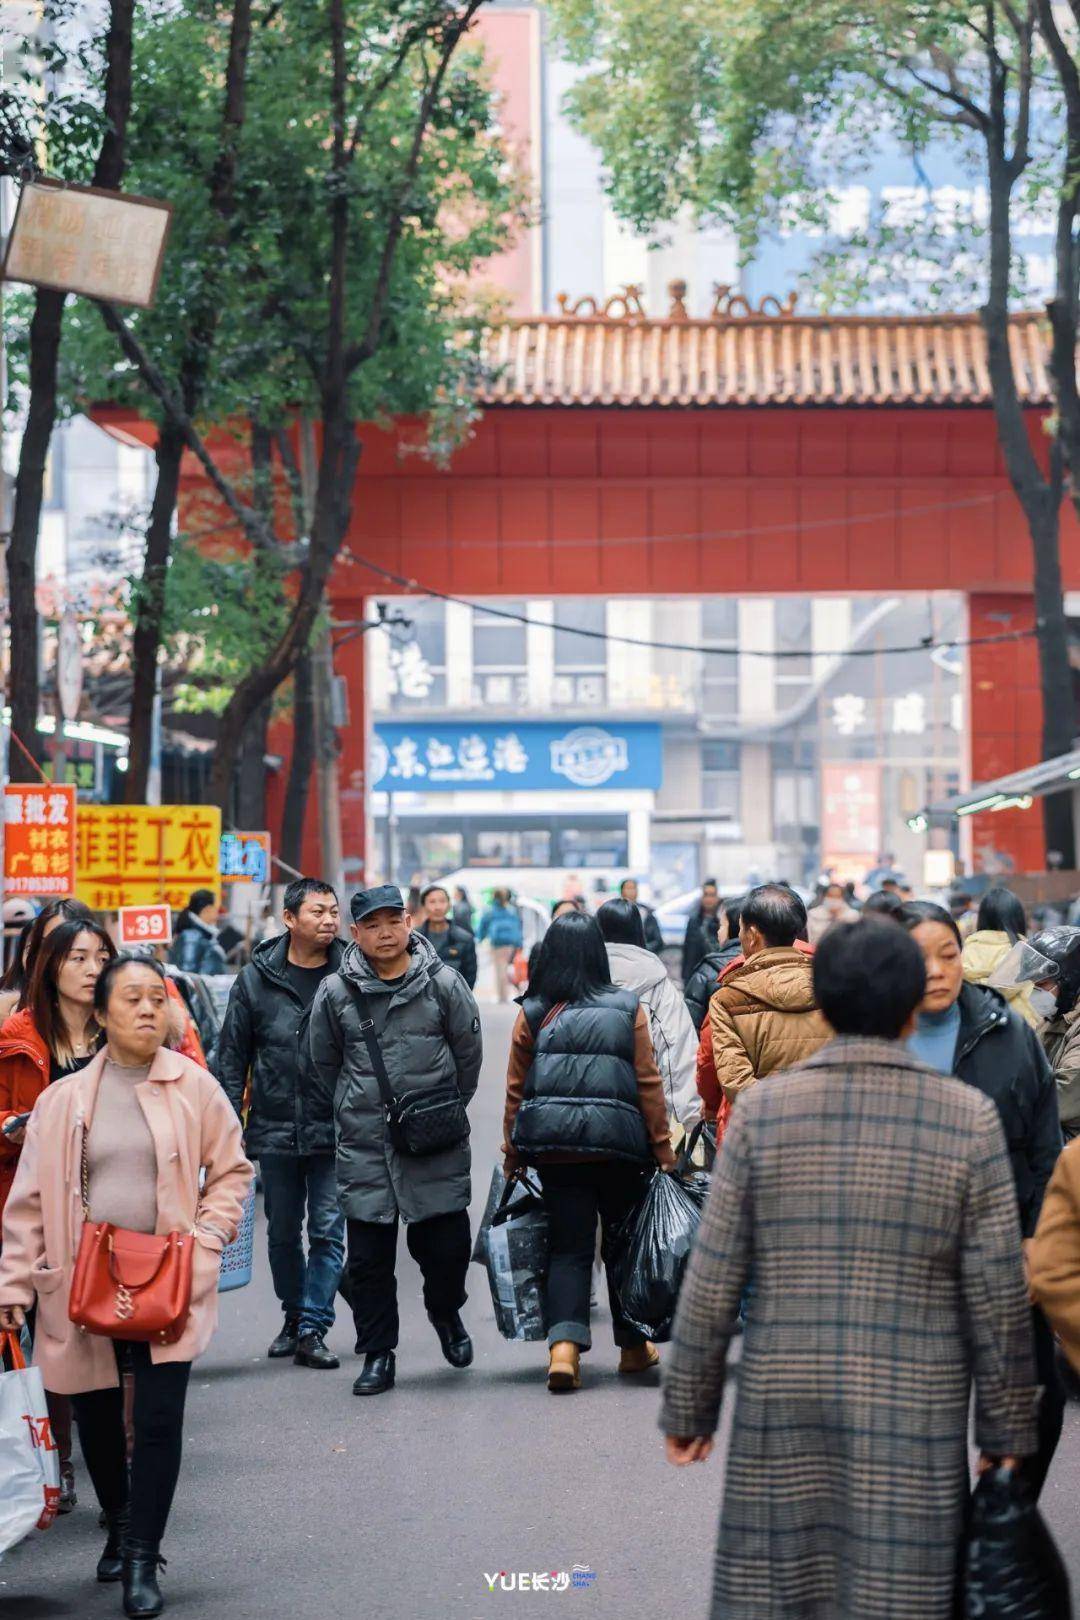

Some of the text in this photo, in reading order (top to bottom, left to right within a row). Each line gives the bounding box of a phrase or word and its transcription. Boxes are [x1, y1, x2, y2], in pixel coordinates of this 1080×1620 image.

[29, 829, 69, 850] 衬衣
[76, 812, 215, 871] 菲菲工衣
[10, 852, 70, 874] 广告衫
